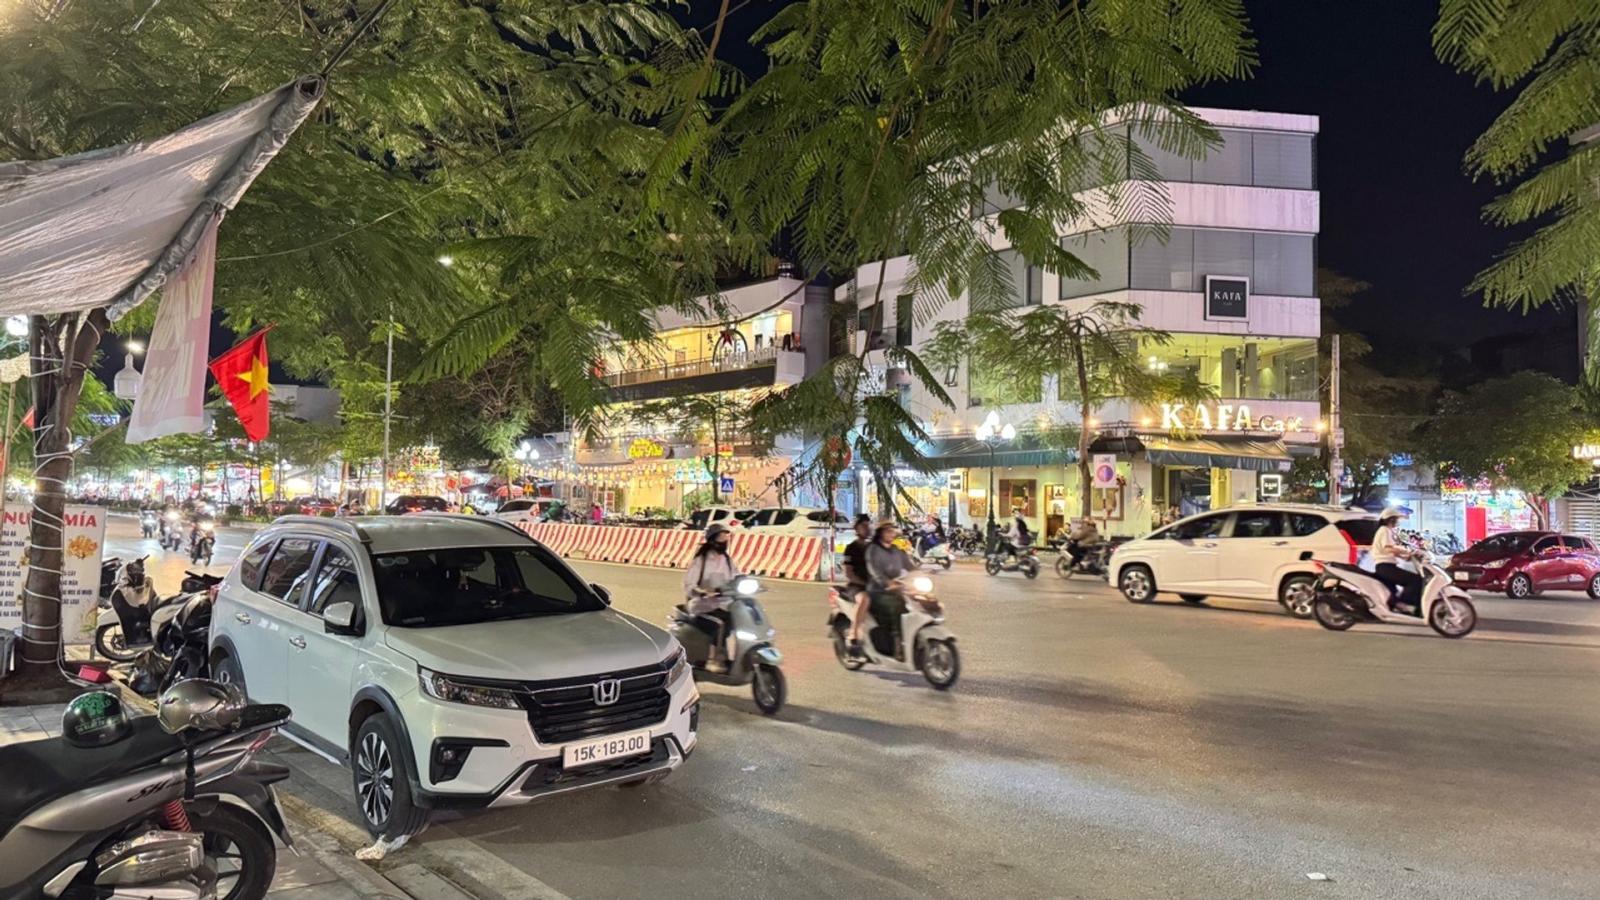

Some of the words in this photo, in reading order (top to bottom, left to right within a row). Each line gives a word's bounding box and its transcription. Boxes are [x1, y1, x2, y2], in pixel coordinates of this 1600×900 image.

[1214, 291, 1241, 301] KAFA
[1160, 402, 1252, 431] KAFA
[64, 510, 97, 527] MÍA
